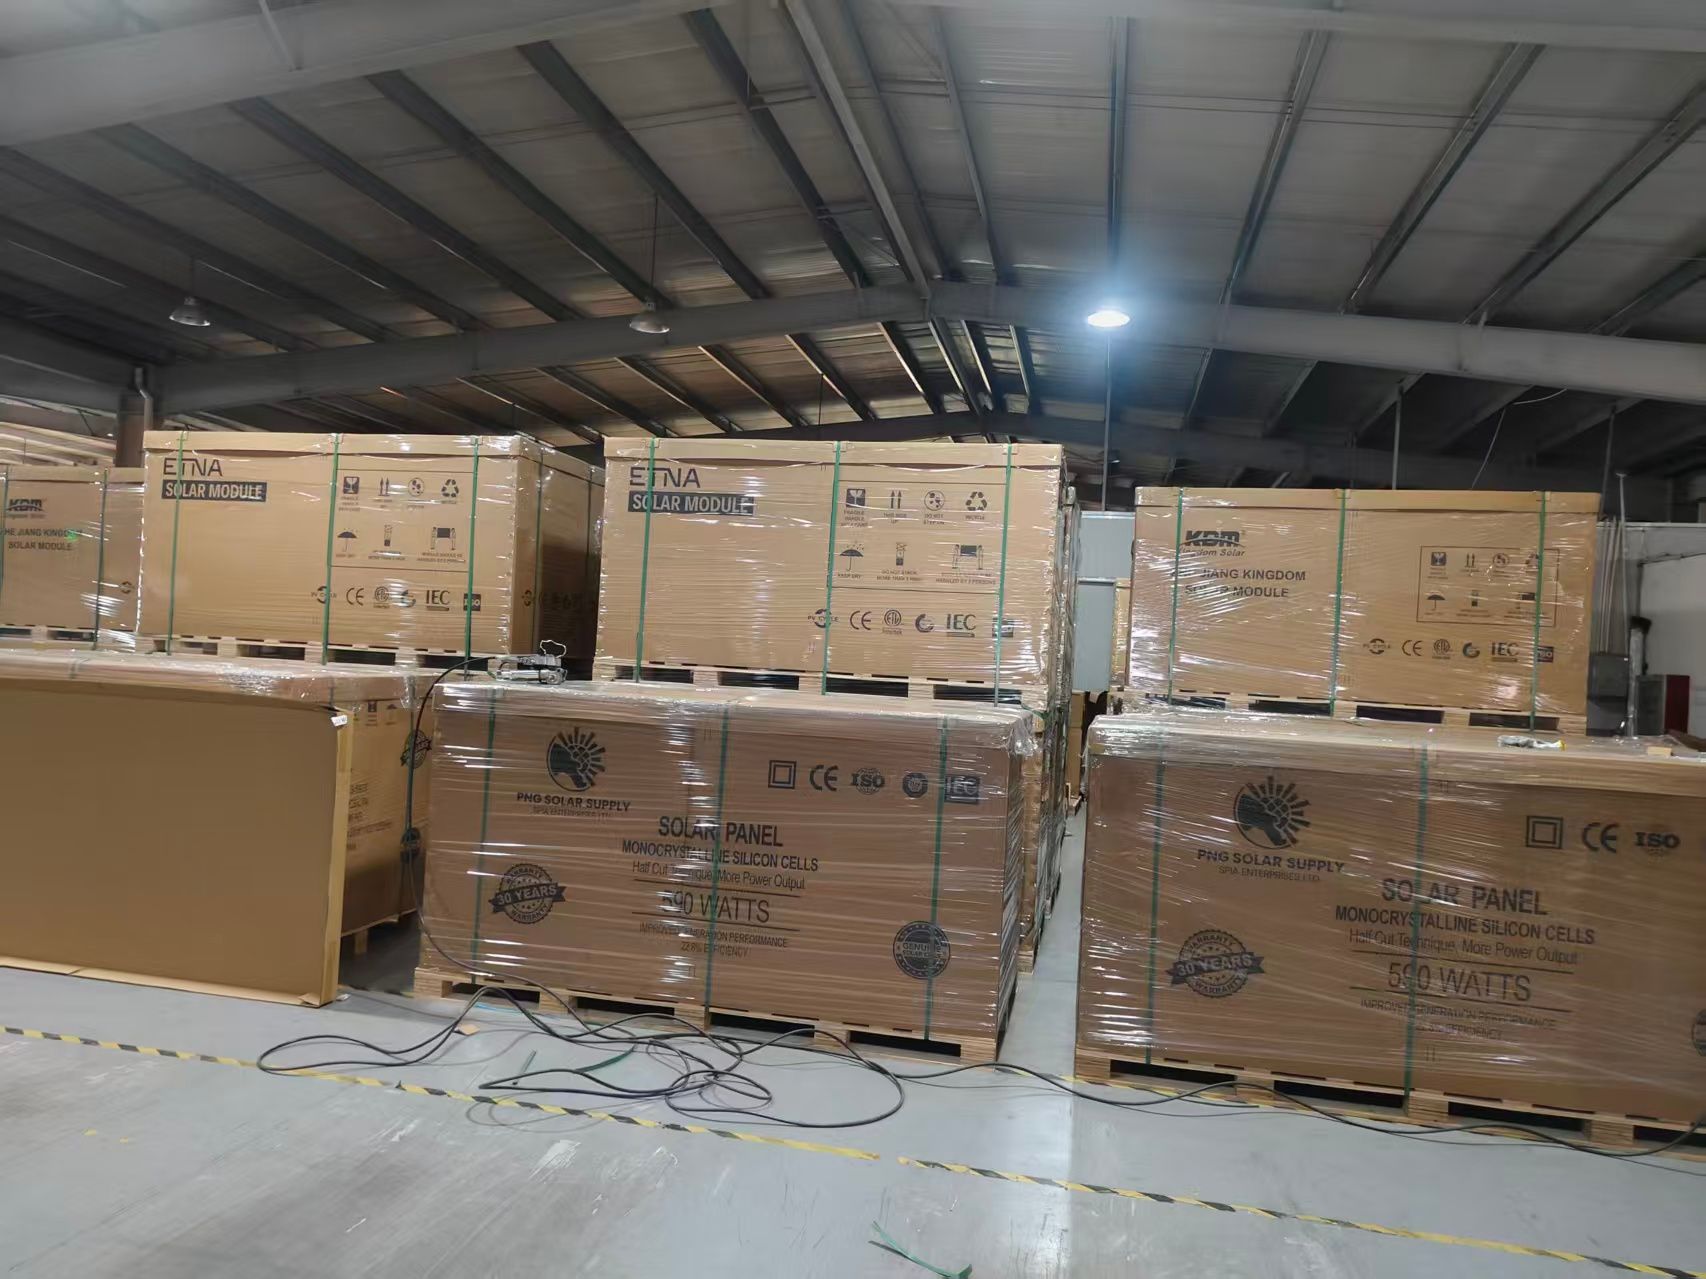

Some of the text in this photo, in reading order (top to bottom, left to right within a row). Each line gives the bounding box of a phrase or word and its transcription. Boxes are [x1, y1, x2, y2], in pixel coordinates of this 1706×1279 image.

[629, 467, 700, 488] ETNA
[165, 484, 262, 499] SOLAR MODULE
[632, 494, 749, 514] SOLAR MODULE
[1219, 548, 1246, 557] Solar
[1243, 569, 1306, 581] KINGDOM
[425, 590, 451, 605] IEC
[1232, 586, 1289, 598] MODULE
[849, 610, 872, 631] CE
[946, 613, 977, 631] IEC
[1401, 639, 1423, 657] CE
[1491, 642, 1519, 656] IEC
[809, 764, 839, 791] CE
[850, 773, 886, 788] ISO
[516, 791, 631, 812] PNG SOLAR SUPPLY
[658, 815, 783, 847] SOLAR PANEL
[1582, 822, 1680, 853] CE ISO
[732, 851, 778, 869] SILICON
[780, 856, 819, 872] CELLS
[1197, 848, 1345, 873] PNG SOLAR SUPPLY
[718, 870, 741, 884] More
[743, 872, 772, 888] Power
[773, 874, 806, 891] Output
[515, 884, 557, 901] YEARS
[1471, 885, 1549, 916] PANEL
[700, 893, 771, 924] WATTS
[1335, 904, 1596, 945] MONOCRYSTALLINE SILICON CELLS
[1461, 937, 1493, 955] More
[1494, 942, 1534, 960] Power
[1535, 949, 1579, 967] Output
[1176, 953, 1254, 977] 30 YEARS
[1438, 967, 1532, 1002] WATTS
